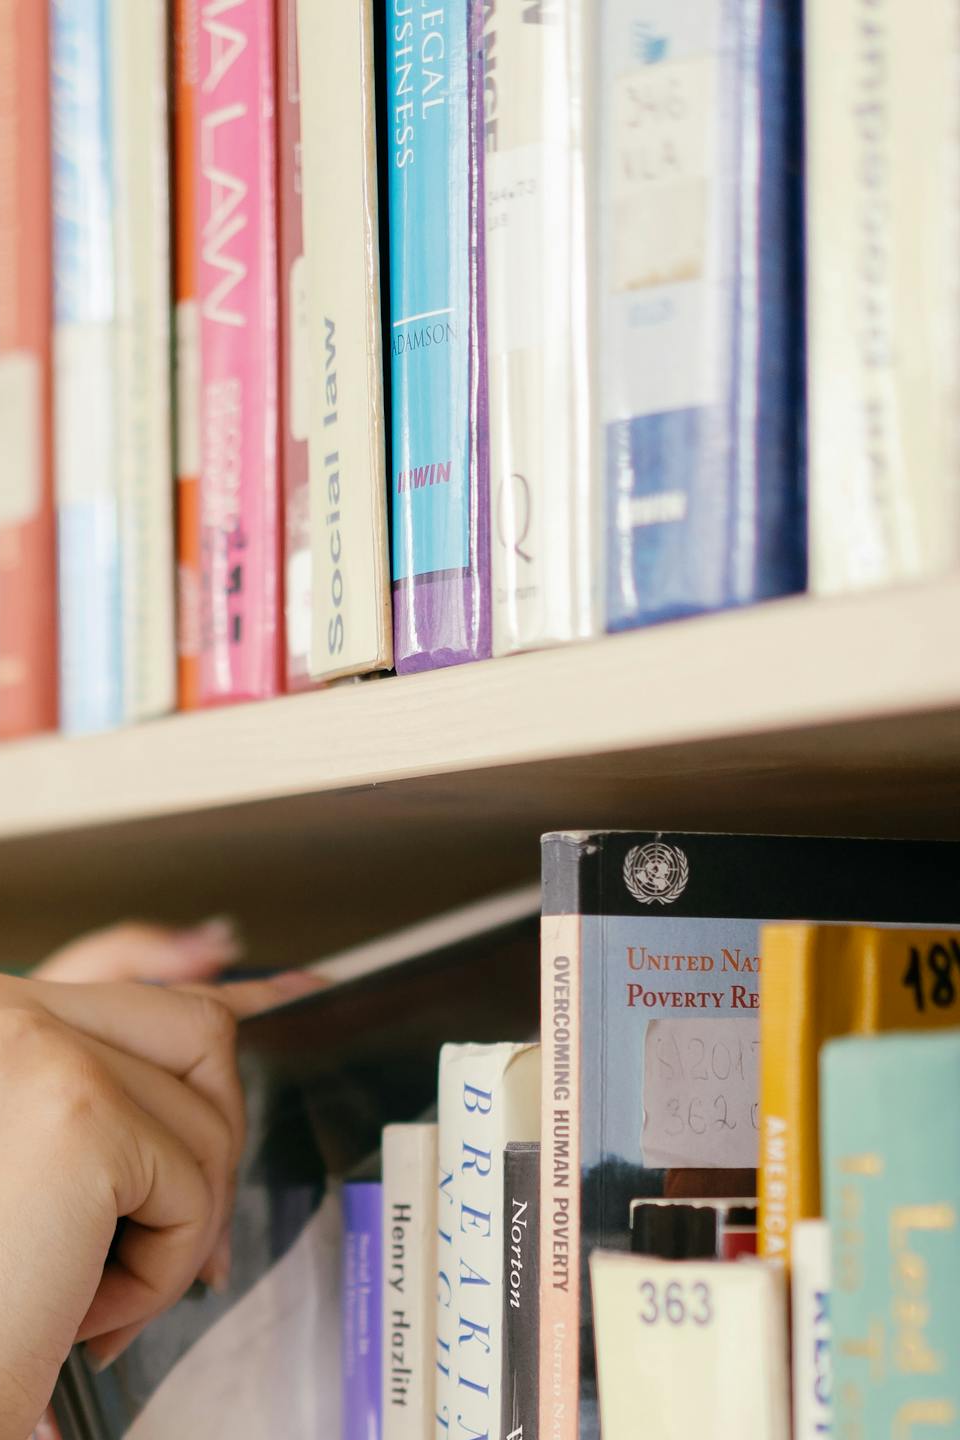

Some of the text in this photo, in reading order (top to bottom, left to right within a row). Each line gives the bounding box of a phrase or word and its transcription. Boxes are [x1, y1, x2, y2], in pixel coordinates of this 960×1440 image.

[421, 0, 445, 120] EGAL
[201, 103, 248, 326] LAW
[391, 321, 457, 357] ADAMSON
[323, 316, 344, 656] Social law
[397, 460, 452, 494] IRWIN
[626, 946, 714, 972] UNITED
[626, 983, 725, 1009] POVERTY
[552, 955, 571, 1294] OVERCOMING HUMAN POVERTY
[389, 1203, 413, 1407] Henry Hazlitt
[509, 1196, 528, 1310] Norton
[639, 1280, 714, 1327] 363
